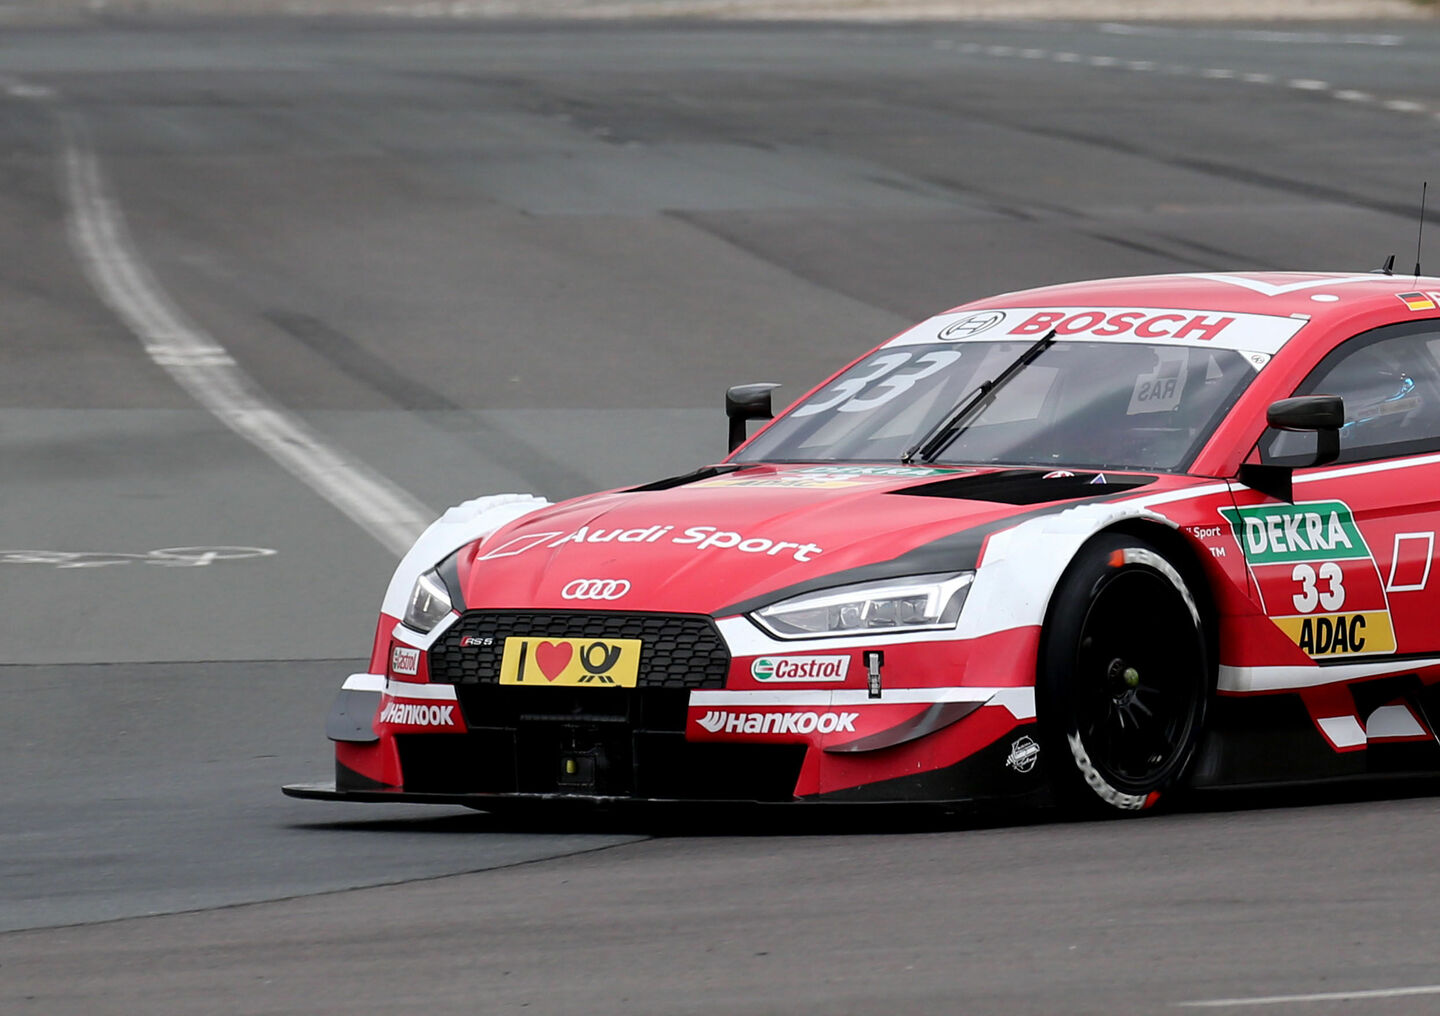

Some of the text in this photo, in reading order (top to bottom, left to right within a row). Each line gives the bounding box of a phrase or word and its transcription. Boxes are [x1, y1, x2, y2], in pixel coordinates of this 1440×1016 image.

[1010, 311, 1237, 342] BOSCH
[791, 350, 962, 417] 33
[548, 525, 824, 562] Audi Sport
[1193, 527, 1222, 540] Sport
[1244, 511, 1353, 555] DEKRA
[1292, 562, 1346, 614] 33
[1299, 614, 1367, 655] ADAC
[396, 648, 417, 672] Castrol
[516, 641, 528, 682] I
[775, 659, 843, 679] Castrol
